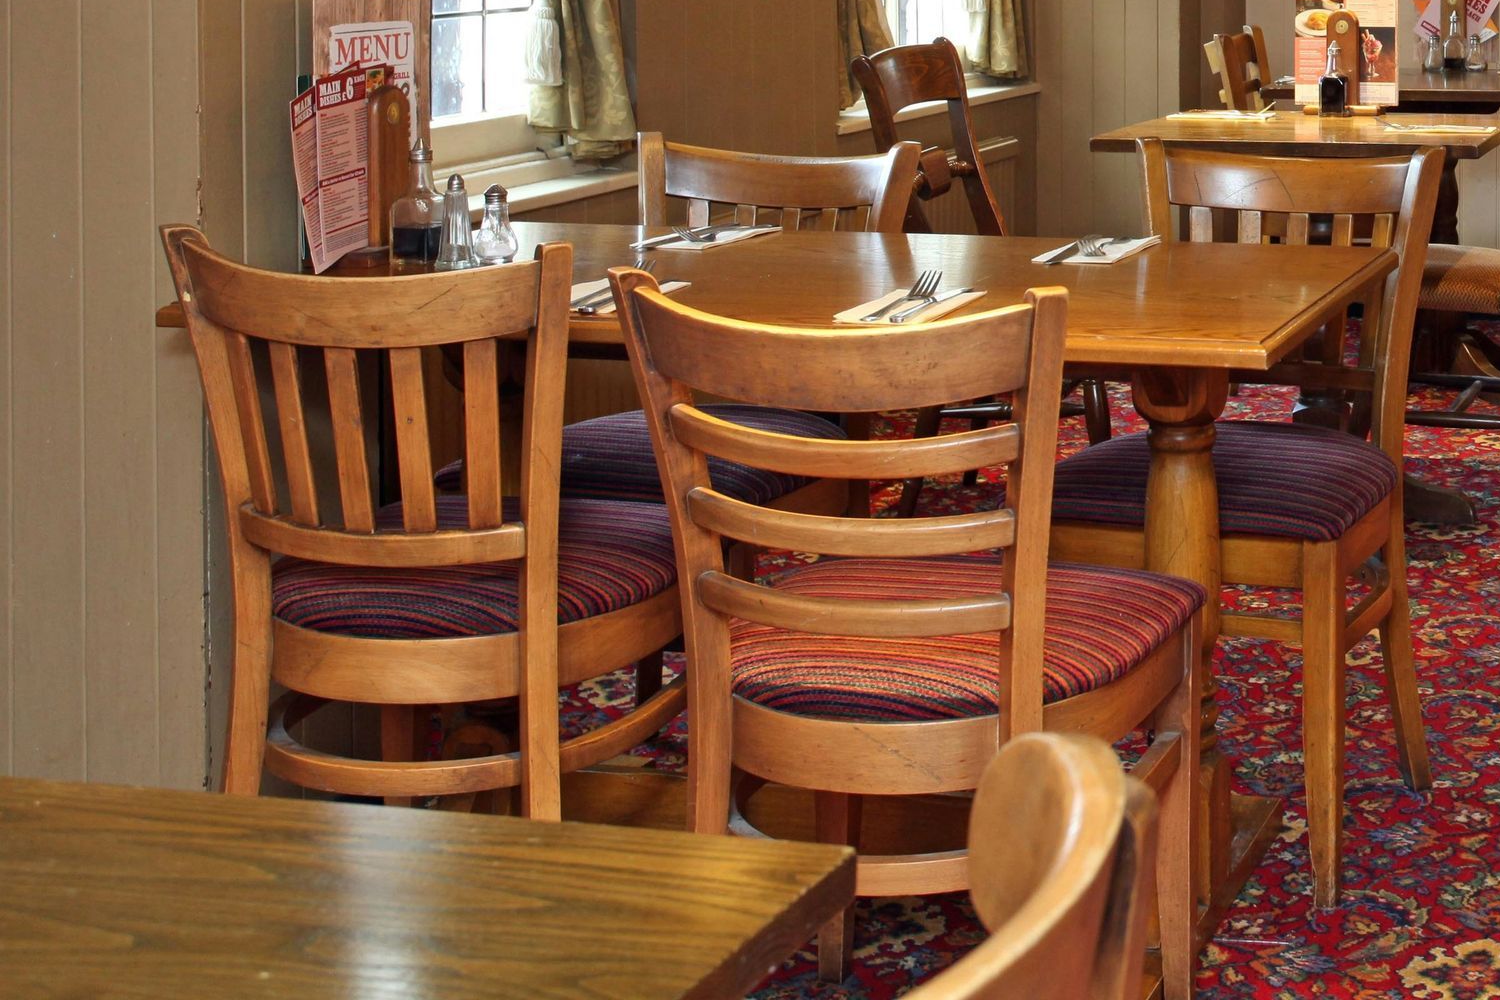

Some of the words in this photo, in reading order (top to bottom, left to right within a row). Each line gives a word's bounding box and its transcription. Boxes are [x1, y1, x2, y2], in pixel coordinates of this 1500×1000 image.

[335, 32, 411, 66] MENU
[319, 79, 341, 97] MAIN
[294, 93, 312, 117] MAIN
[319, 92, 342, 107] DISHES
